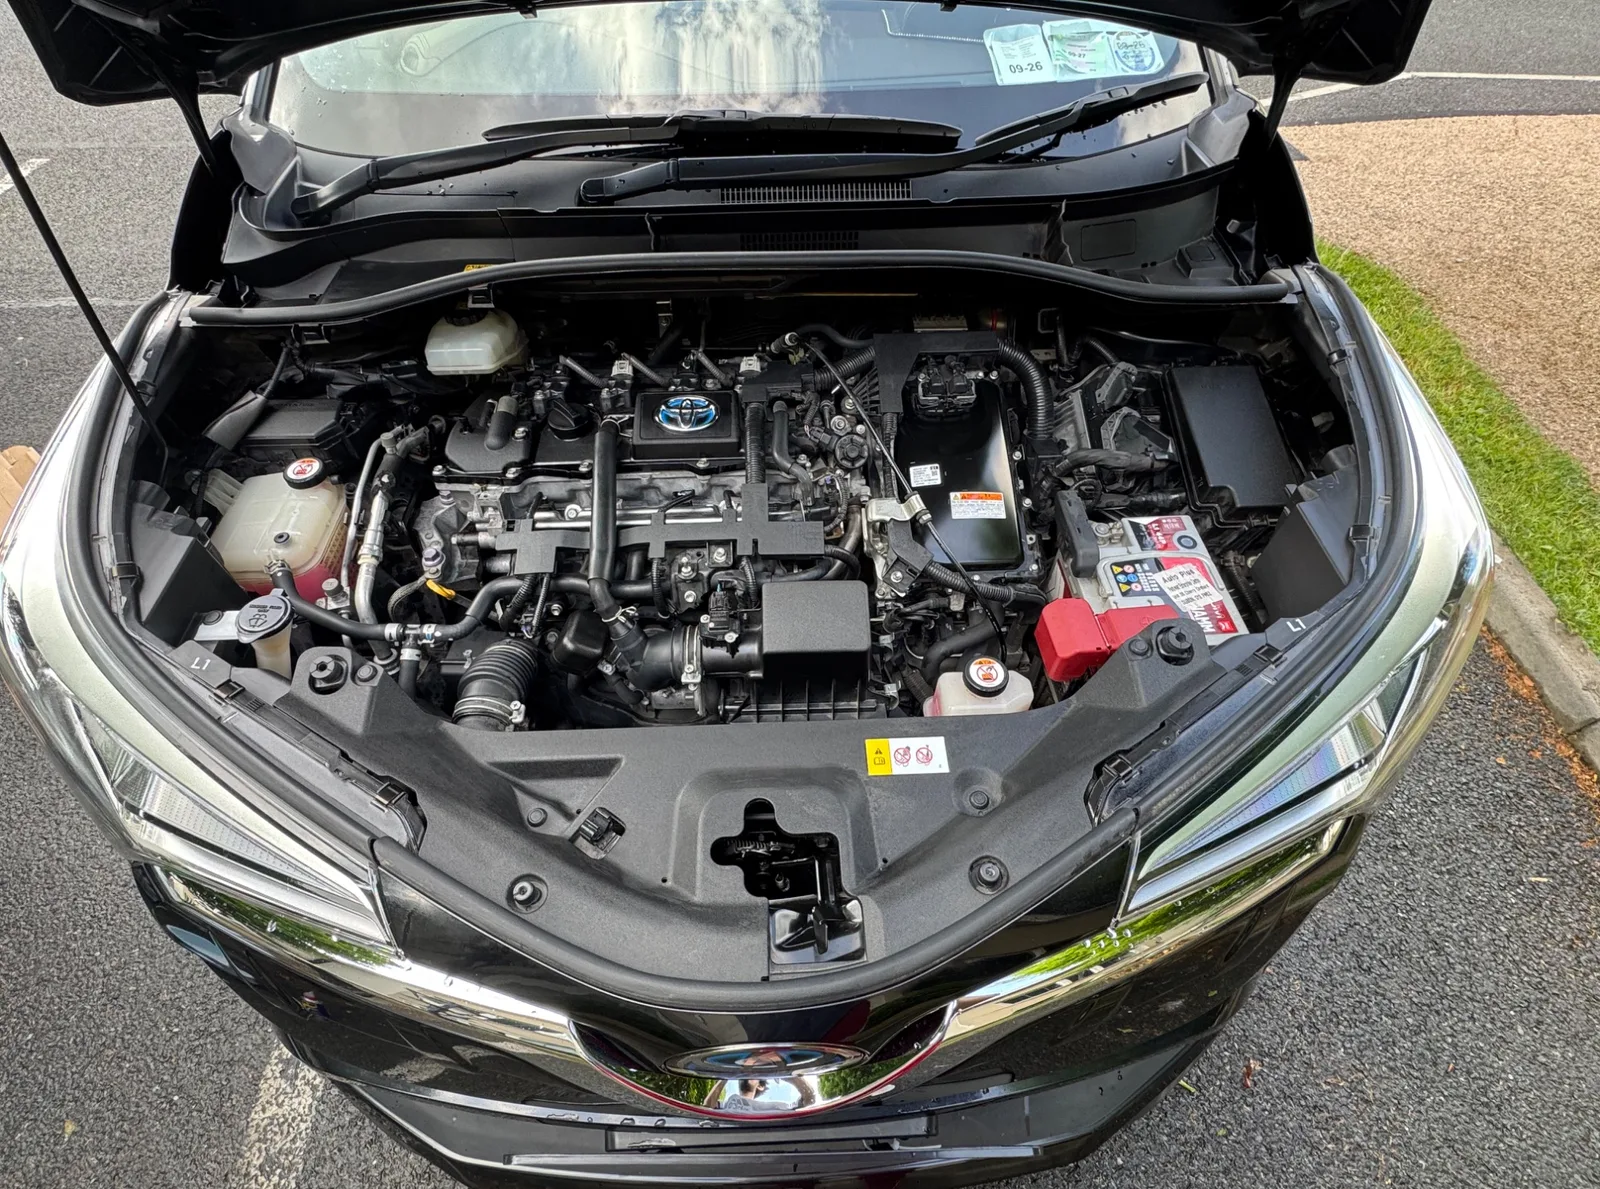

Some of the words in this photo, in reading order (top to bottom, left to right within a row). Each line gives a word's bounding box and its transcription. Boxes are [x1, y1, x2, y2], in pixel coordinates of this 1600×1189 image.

[1009, 61, 1043, 74] 09-26
[1162, 574, 1179, 584] Auto
[1179, 569, 1195, 577] Plus
[1286, 618, 1307, 632] L1
[190, 656, 211, 670] L1
